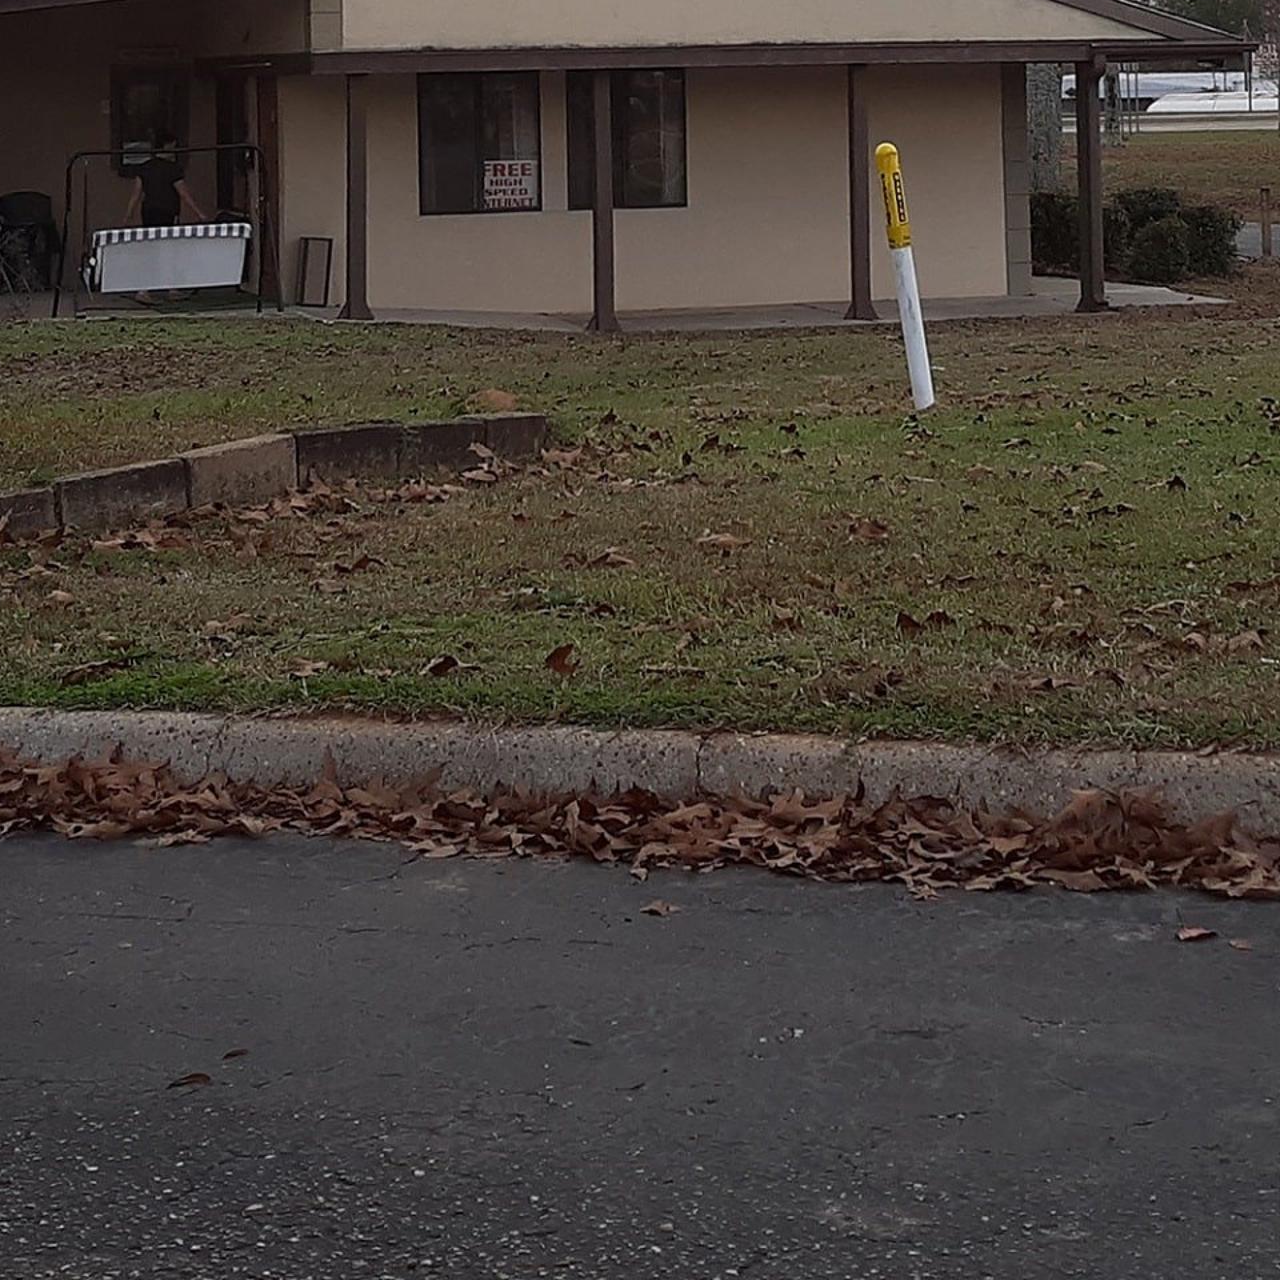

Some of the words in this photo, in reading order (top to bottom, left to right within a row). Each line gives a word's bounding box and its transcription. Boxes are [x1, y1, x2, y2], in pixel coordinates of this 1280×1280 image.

[484, 162, 533, 177] FREE
[490, 178, 523, 187] HIGH
[485, 188, 528, 197] SPEED
[484, 198, 534, 208] NTERNET
